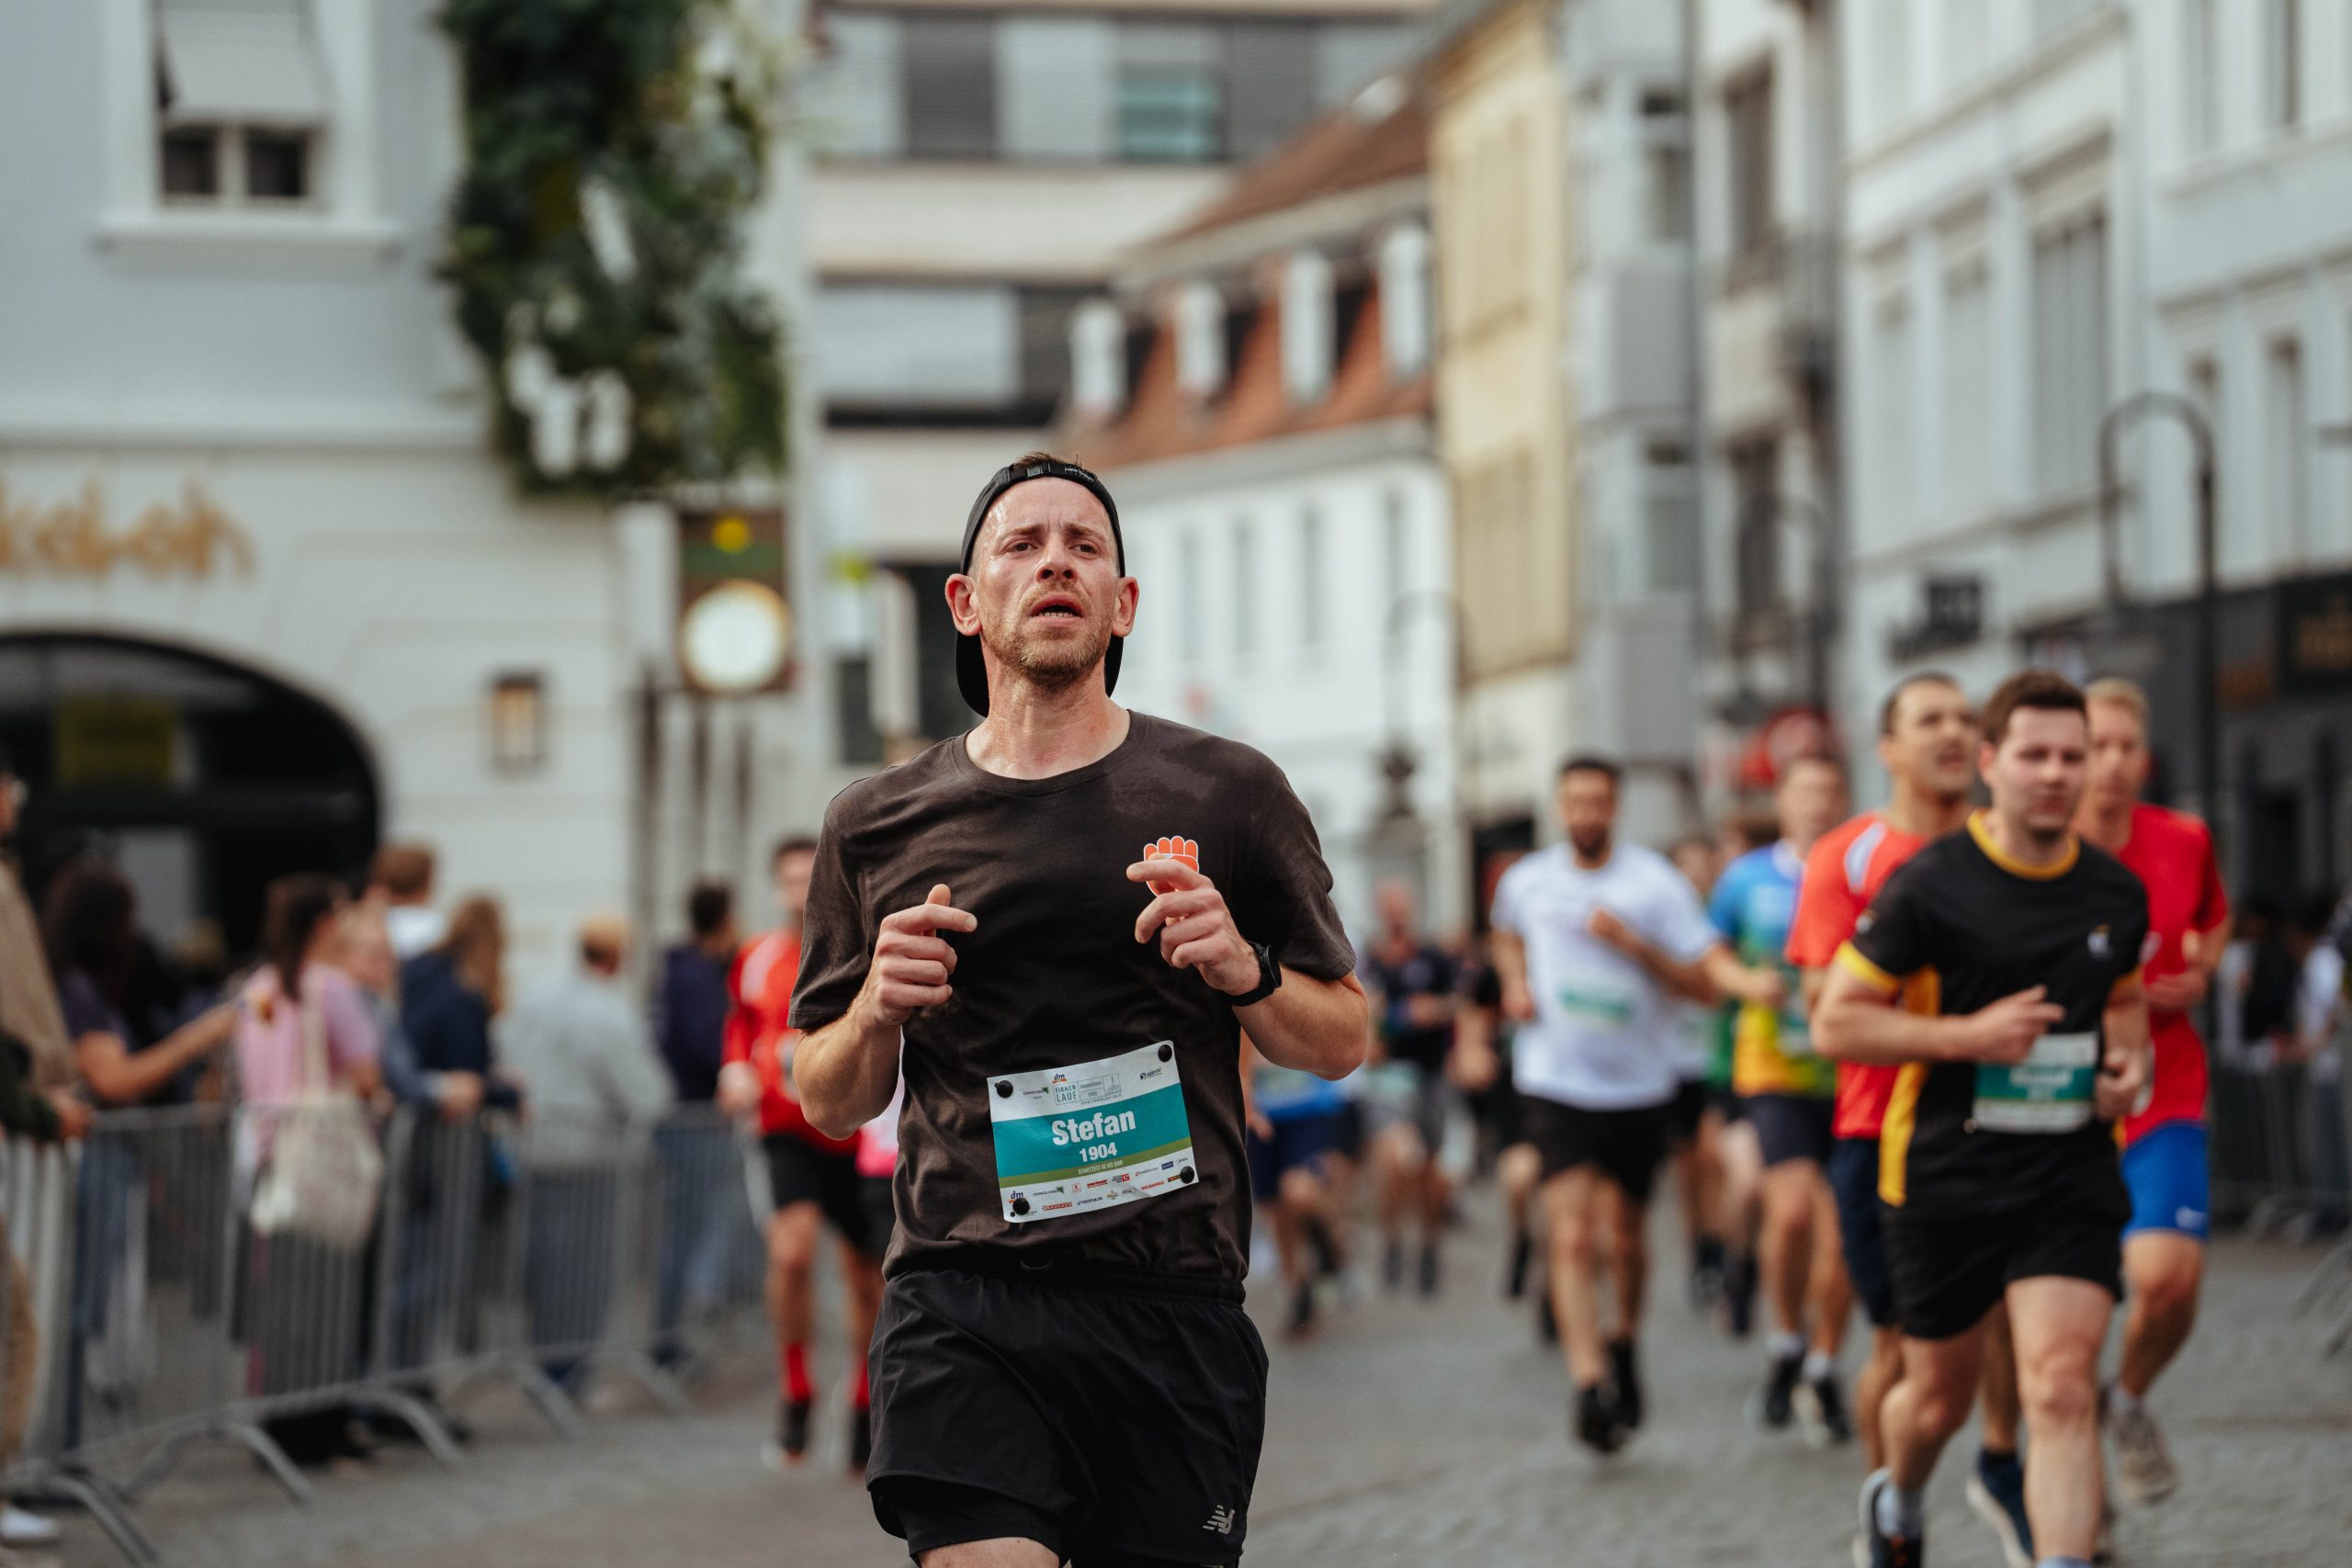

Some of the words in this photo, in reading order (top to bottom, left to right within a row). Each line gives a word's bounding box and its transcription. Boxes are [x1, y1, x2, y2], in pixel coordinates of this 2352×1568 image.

[1055, 1085, 1077, 1093] FIRMEN
[1056, 1091, 1077, 1102] LAUF
[1051, 1111, 1136, 1145] Stefan
[1079, 1142, 1117, 1162] 1904
[1011, 1190, 1023, 1199] dm
